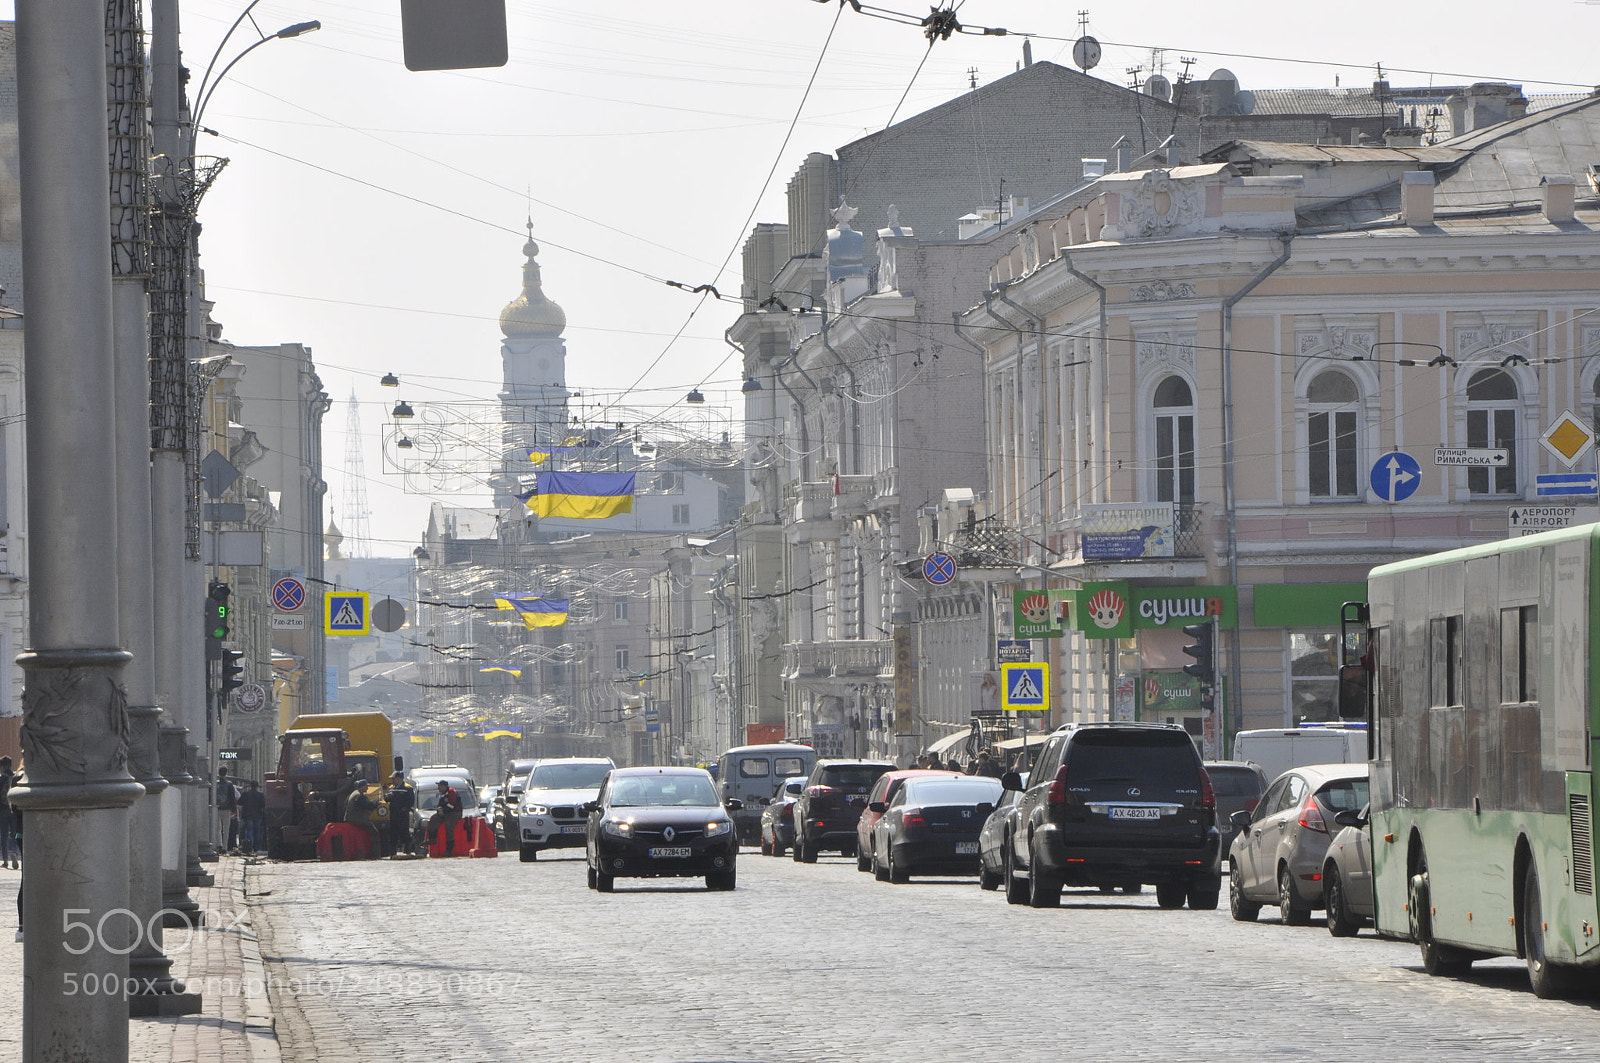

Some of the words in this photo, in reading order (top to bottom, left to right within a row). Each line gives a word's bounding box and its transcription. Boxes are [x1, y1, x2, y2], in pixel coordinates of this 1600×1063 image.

[1437, 456, 1491, 464] РИМАРСЬКА
[1522, 508, 1576, 516] АЕРОПОРТ
[1522, 517, 1569, 525] AIRPORT
[218, 606, 225, 618] 9
[1113, 808, 1125, 818] AX
[1127, 808, 1146, 818] 4820
[1147, 809, 1159, 818] AK
